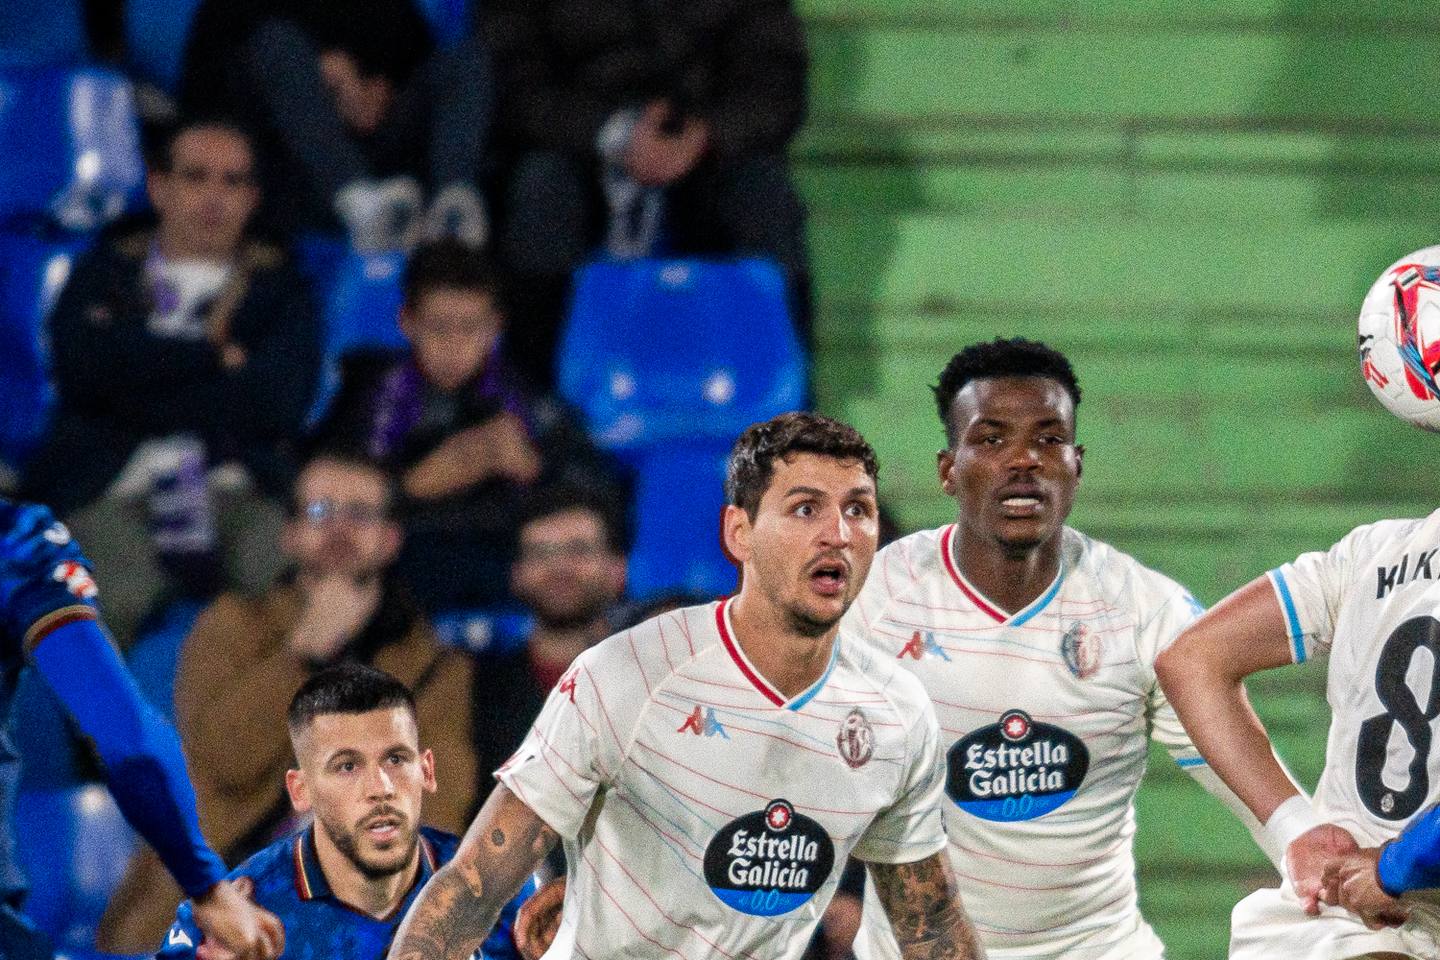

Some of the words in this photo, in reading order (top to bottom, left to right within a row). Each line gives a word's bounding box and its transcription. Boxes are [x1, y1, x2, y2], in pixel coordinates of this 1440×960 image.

[964, 740, 1069, 770] Estrella
[969, 767, 1063, 797] Galicia
[727, 829, 818, 862] Estrella
[728, 858, 808, 888] Galicia
